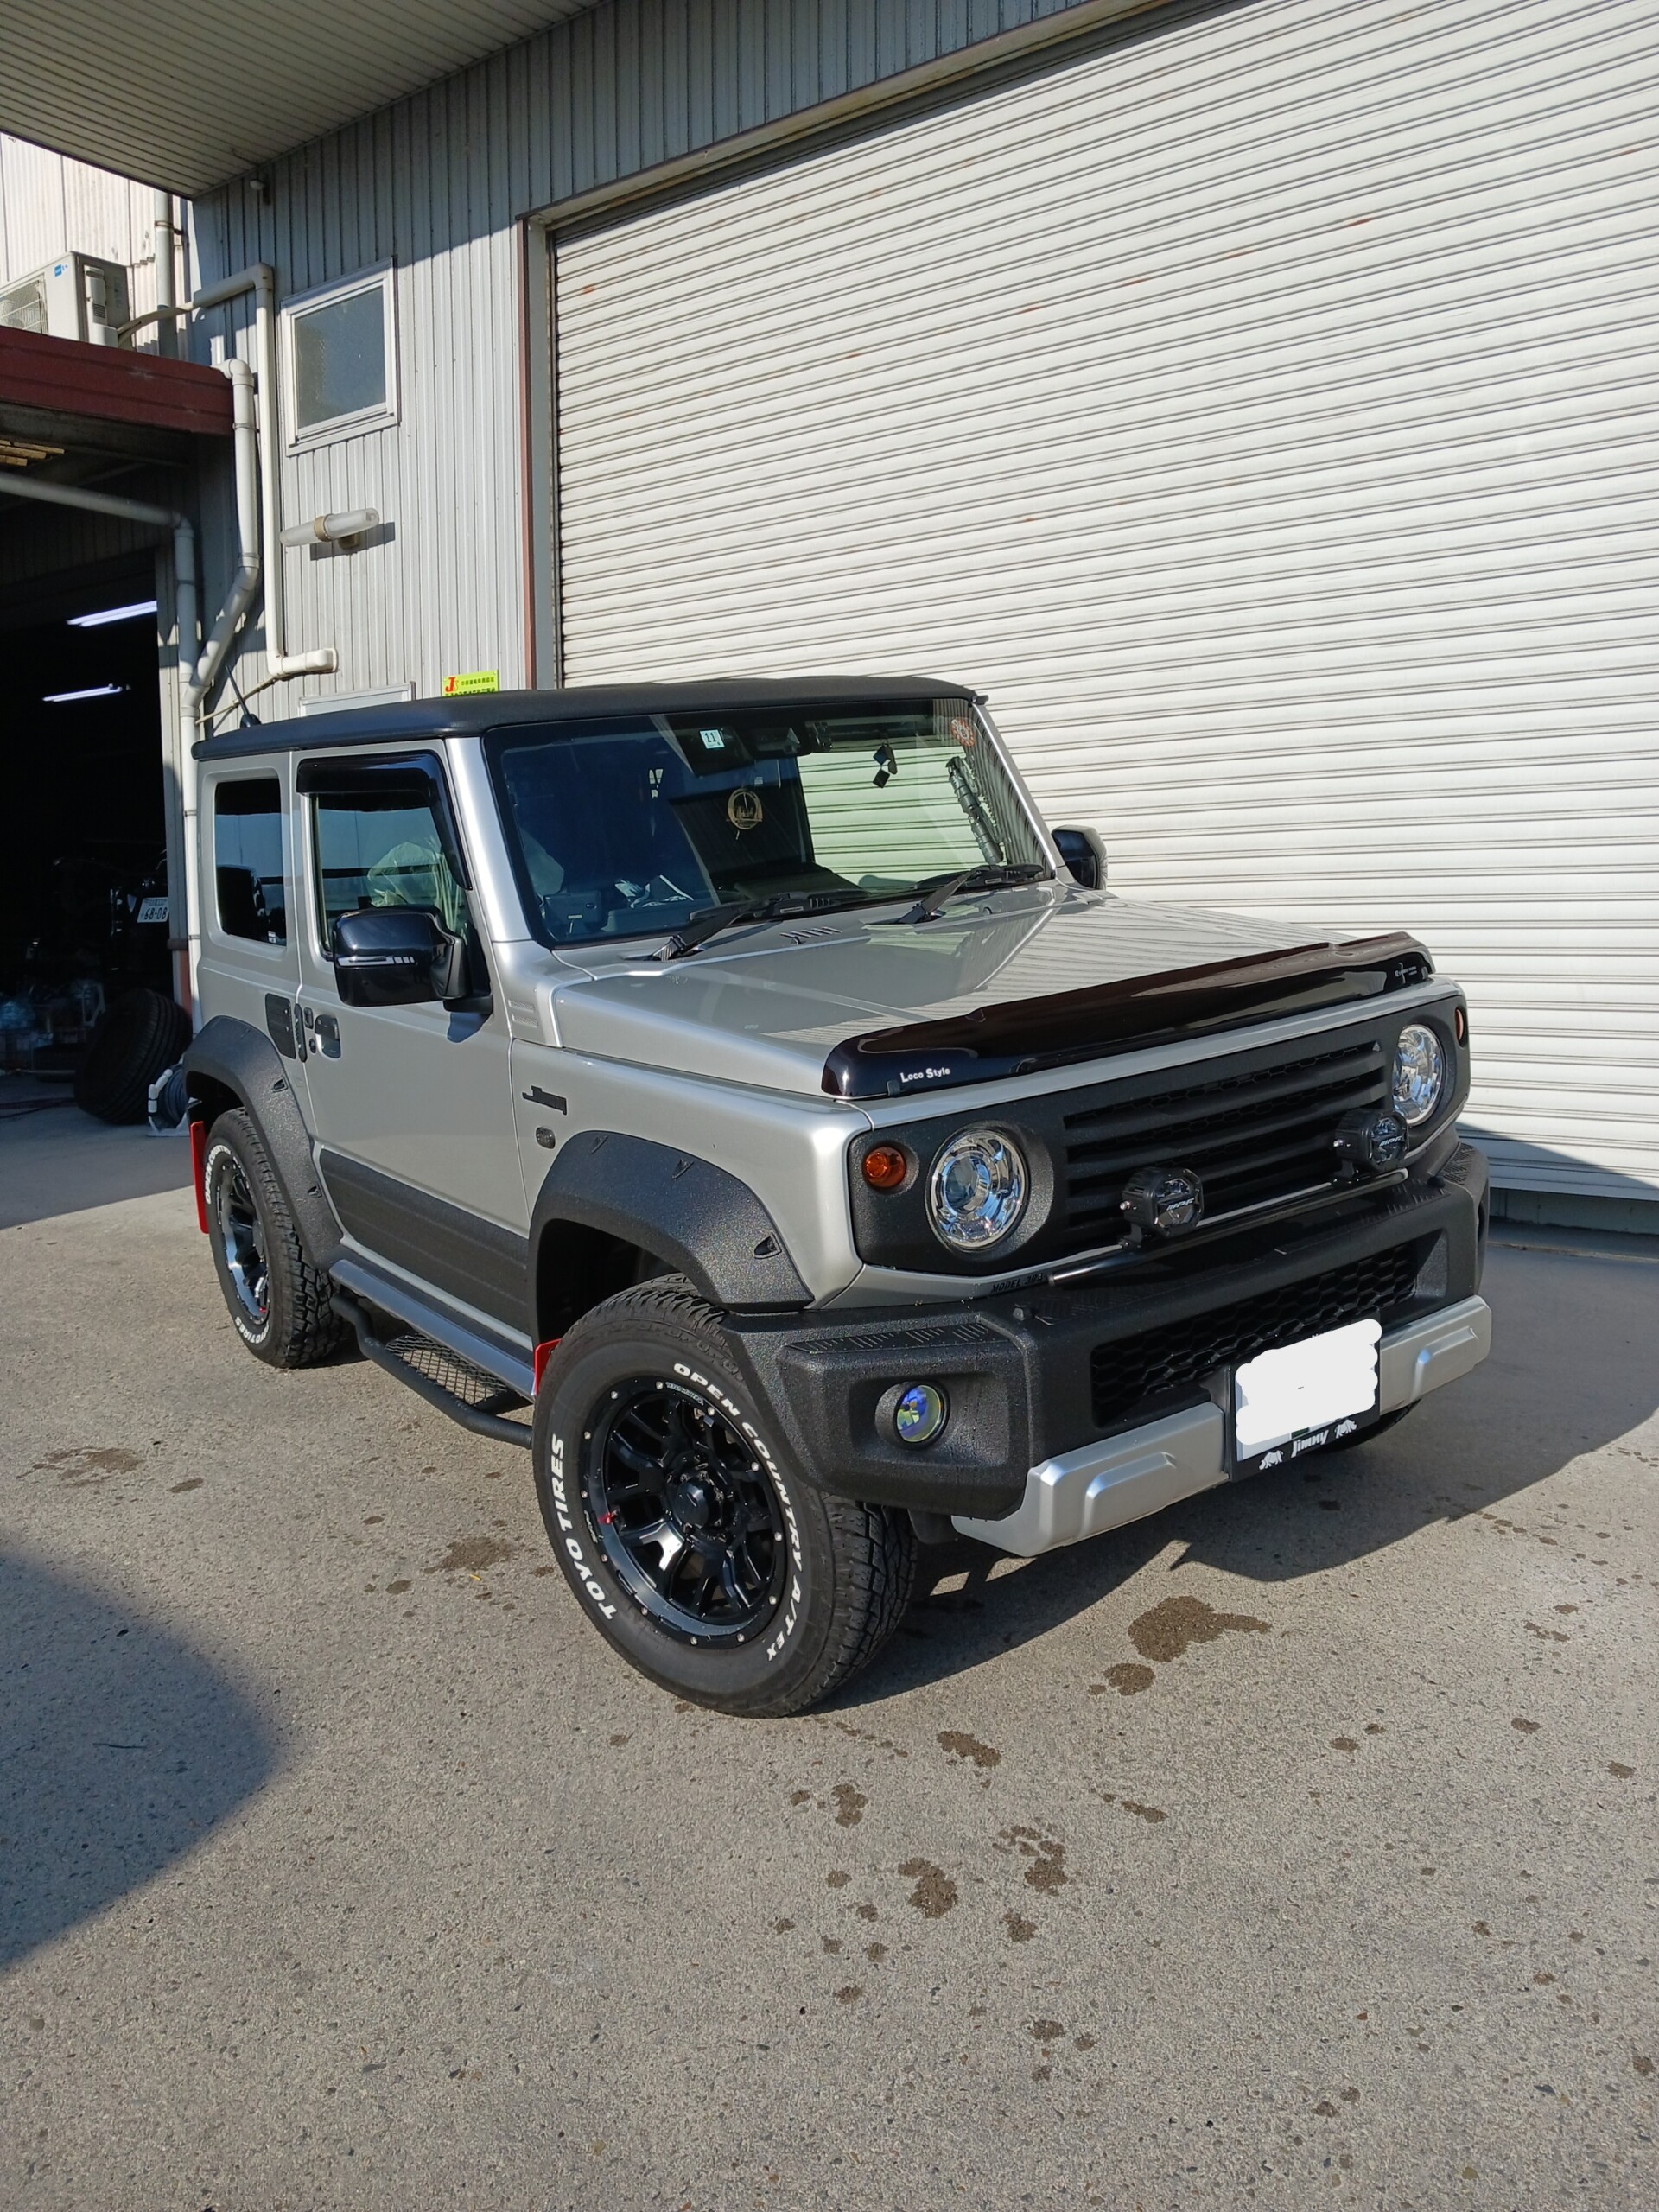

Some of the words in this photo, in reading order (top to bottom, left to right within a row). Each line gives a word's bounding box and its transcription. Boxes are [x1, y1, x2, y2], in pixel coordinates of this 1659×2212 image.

[704, 732, 717, 742] 11
[899, 1071, 925, 1083] Loco
[925, 1066, 950, 1079] Style
[673, 1363, 741, 1417] OPEN
[551, 1434, 573, 1531] TIRES
[741, 1421, 803, 1572] COUNTRY
[566, 1536, 617, 1620] TOYO
[785, 1574, 801, 1636] A/T
[766, 1630, 785, 1662] EX
